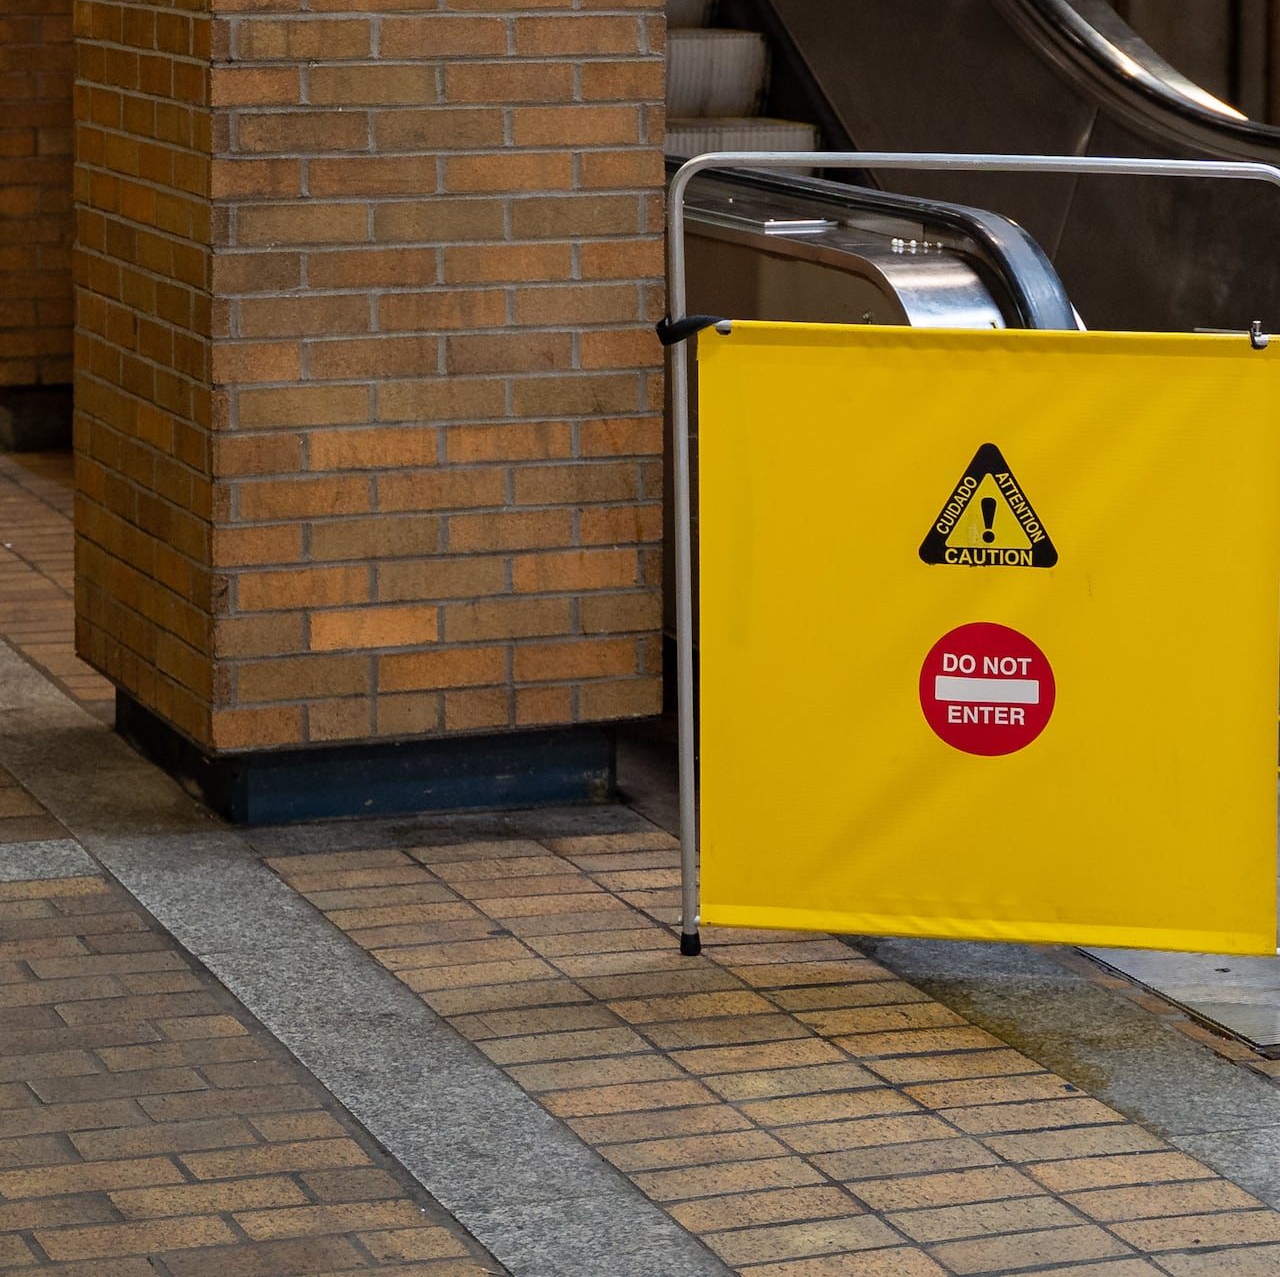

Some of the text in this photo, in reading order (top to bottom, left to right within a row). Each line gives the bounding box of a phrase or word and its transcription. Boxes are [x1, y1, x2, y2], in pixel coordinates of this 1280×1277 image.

[937, 476, 978, 535] CUIDADO
[995, 472, 1045, 543] ATTENTION
[945, 548, 1033, 566] CAUTION
[942, 653, 1032, 675] DO NOT
[947, 705, 1025, 725] ENTER
